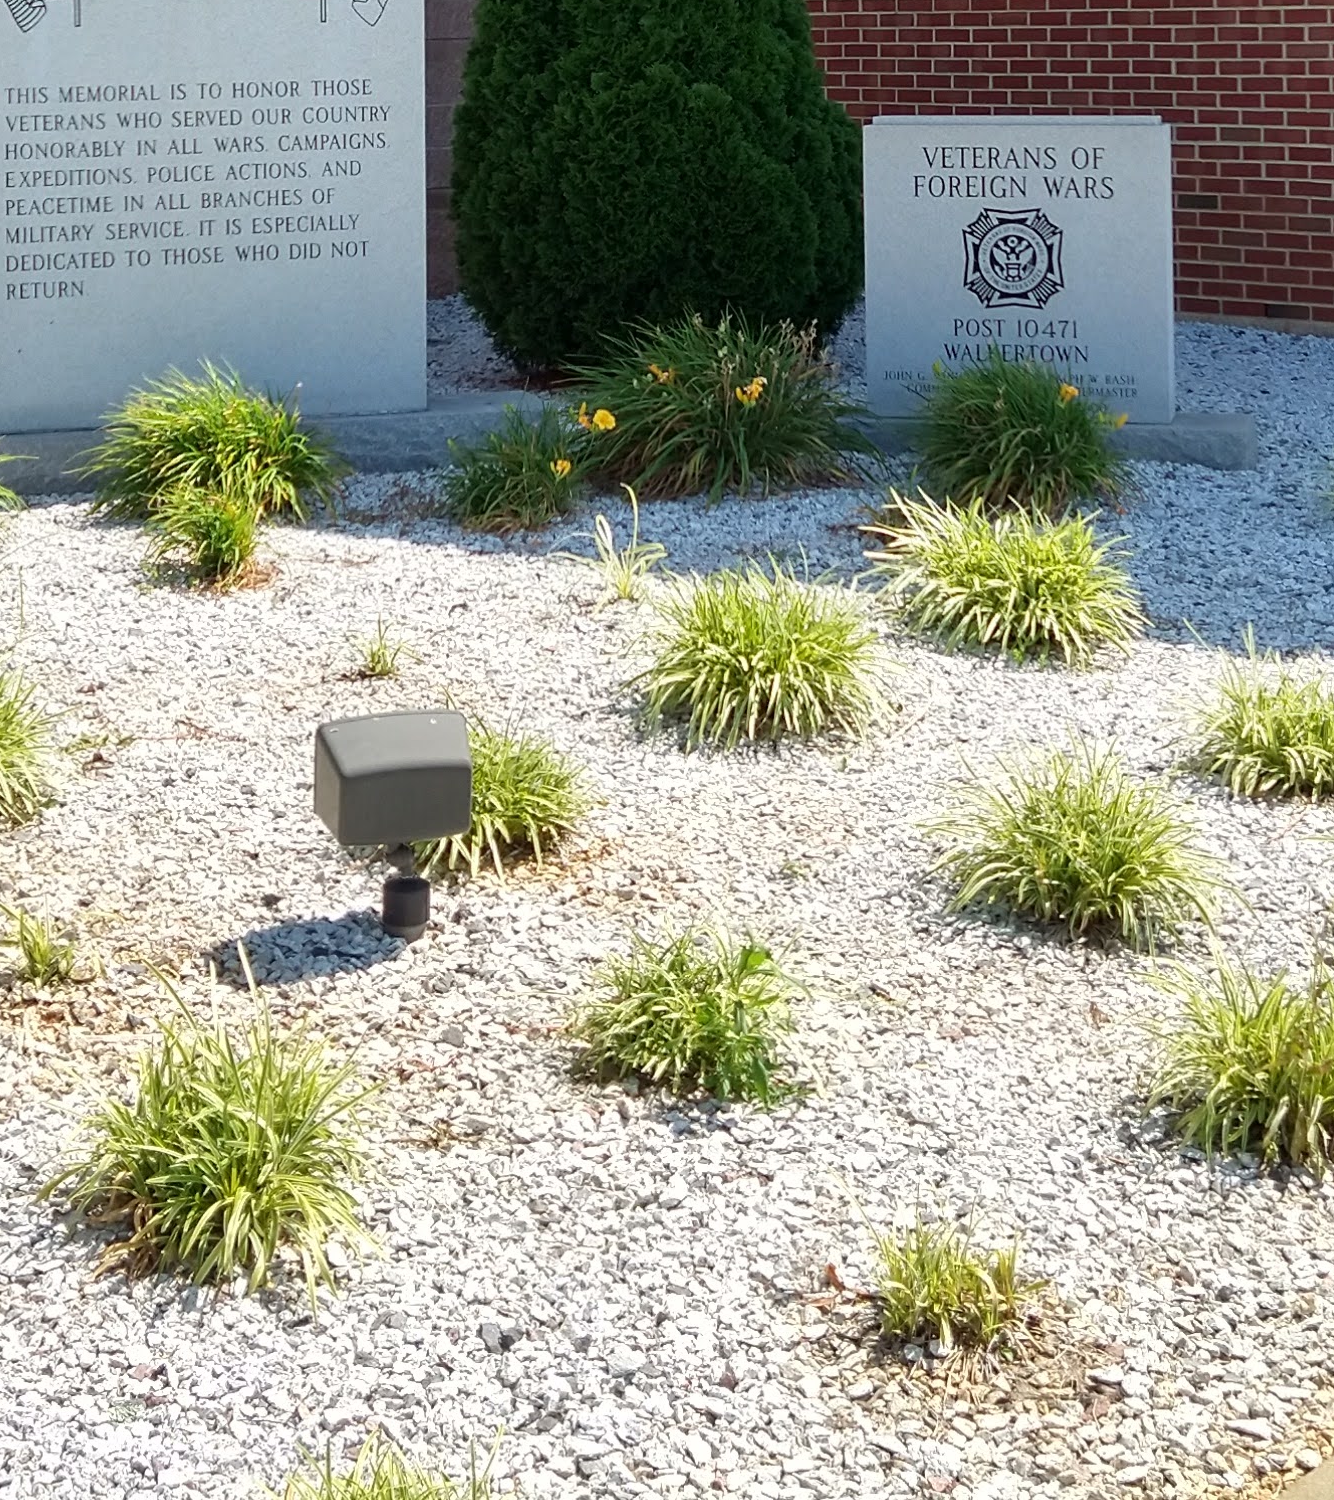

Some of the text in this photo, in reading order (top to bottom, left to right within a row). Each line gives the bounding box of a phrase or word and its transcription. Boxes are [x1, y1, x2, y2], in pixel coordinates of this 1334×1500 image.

[4, 79, 373, 104] THIS MEMORIAL IS TO HONOR THOSE
[5, 105, 391, 132] VETERANS WHO SERVED OUR COUNTRY
[4, 141, 126, 160] HONORABLY
[137, 140, 157, 156] IN
[167, 139, 203, 155] ALL
[922, 147, 1105, 169] VETERANS OF
[147, 165, 215, 184] POLICE
[321, 160, 361, 177] AND
[914, 175, 1114, 199] FOREIGN WARS
[5, 188, 335, 216] PEACETIME IN ALL BRANCHES OF
[6, 225, 94, 244] MILITARY
[199, 219, 215, 236] IT
[225, 218, 241, 235] IS
[252, 214, 360, 234] ESPECIALLY
[6, 241, 369, 272] DEDICATED TO THOSE WHO DID NOT
[954, 319, 1077, 338] POST 10471
[883, 371, 912, 380] JOHN
